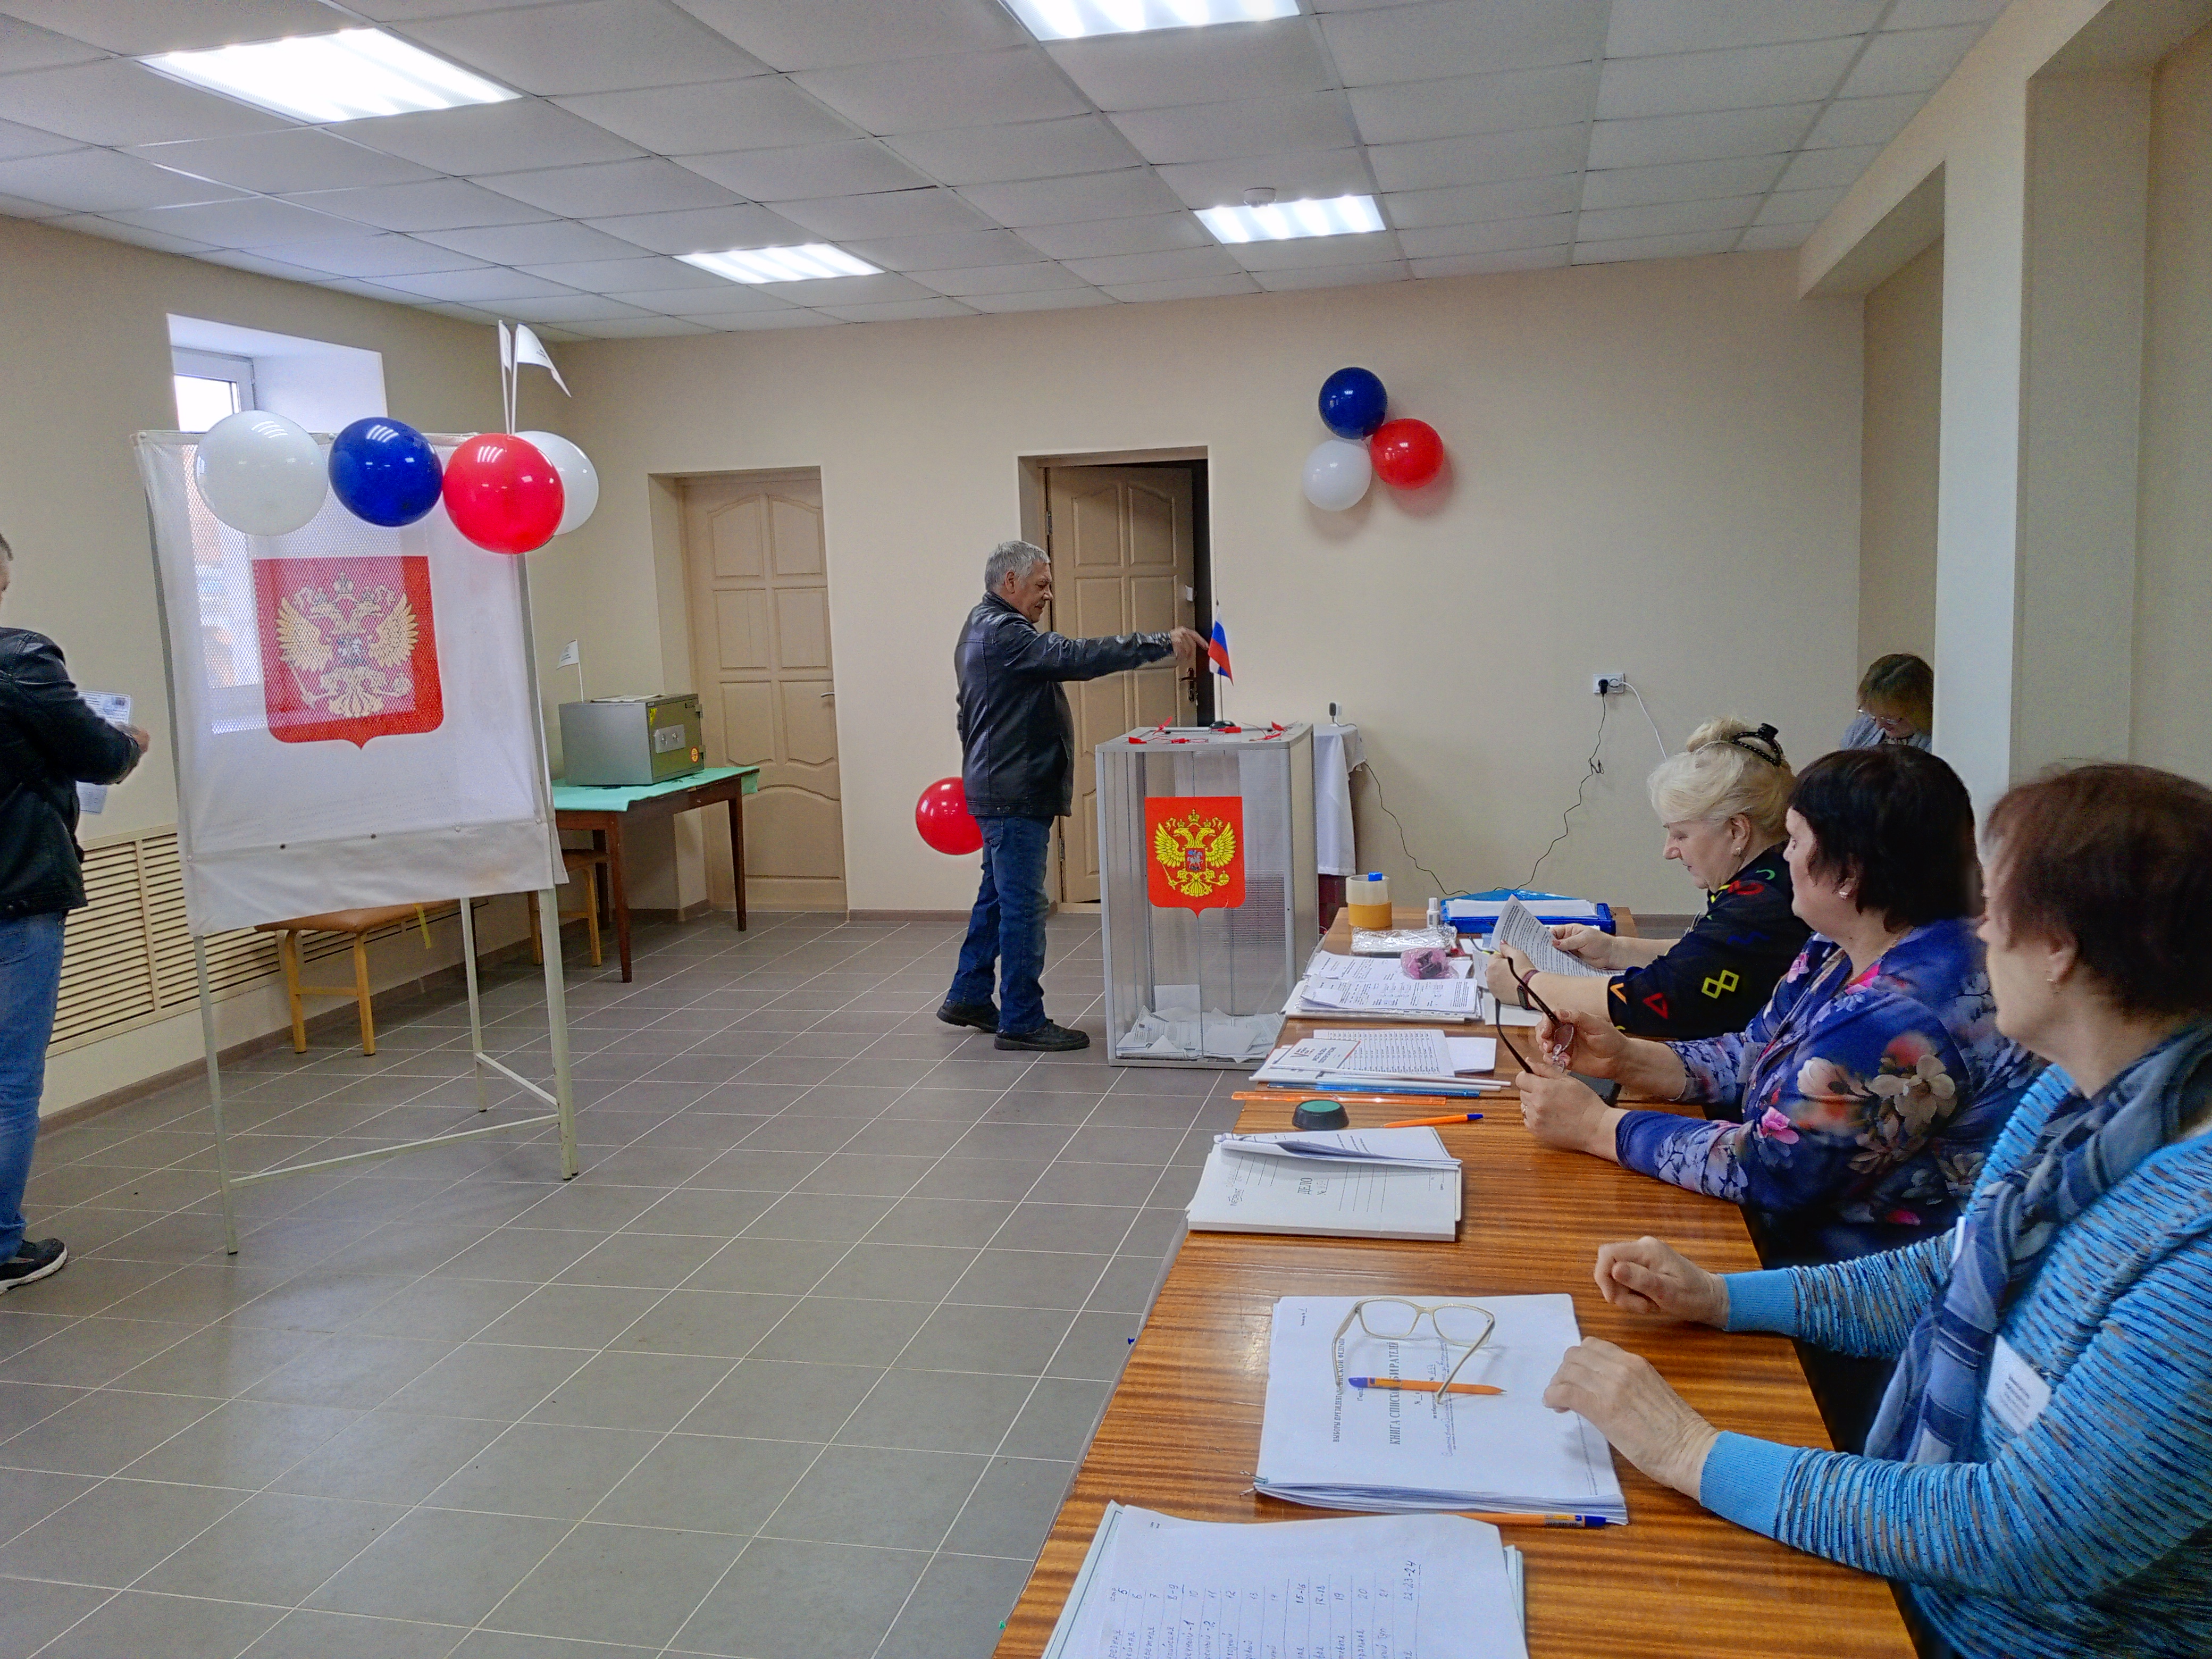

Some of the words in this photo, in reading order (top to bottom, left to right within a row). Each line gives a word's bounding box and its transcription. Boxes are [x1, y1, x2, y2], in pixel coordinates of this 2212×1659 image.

[1297, 1177, 1312, 1195] ДЕЛО
[1390, 1420, 1400, 1445] КНИГА
[1358, 1589, 1368, 1599] 20
